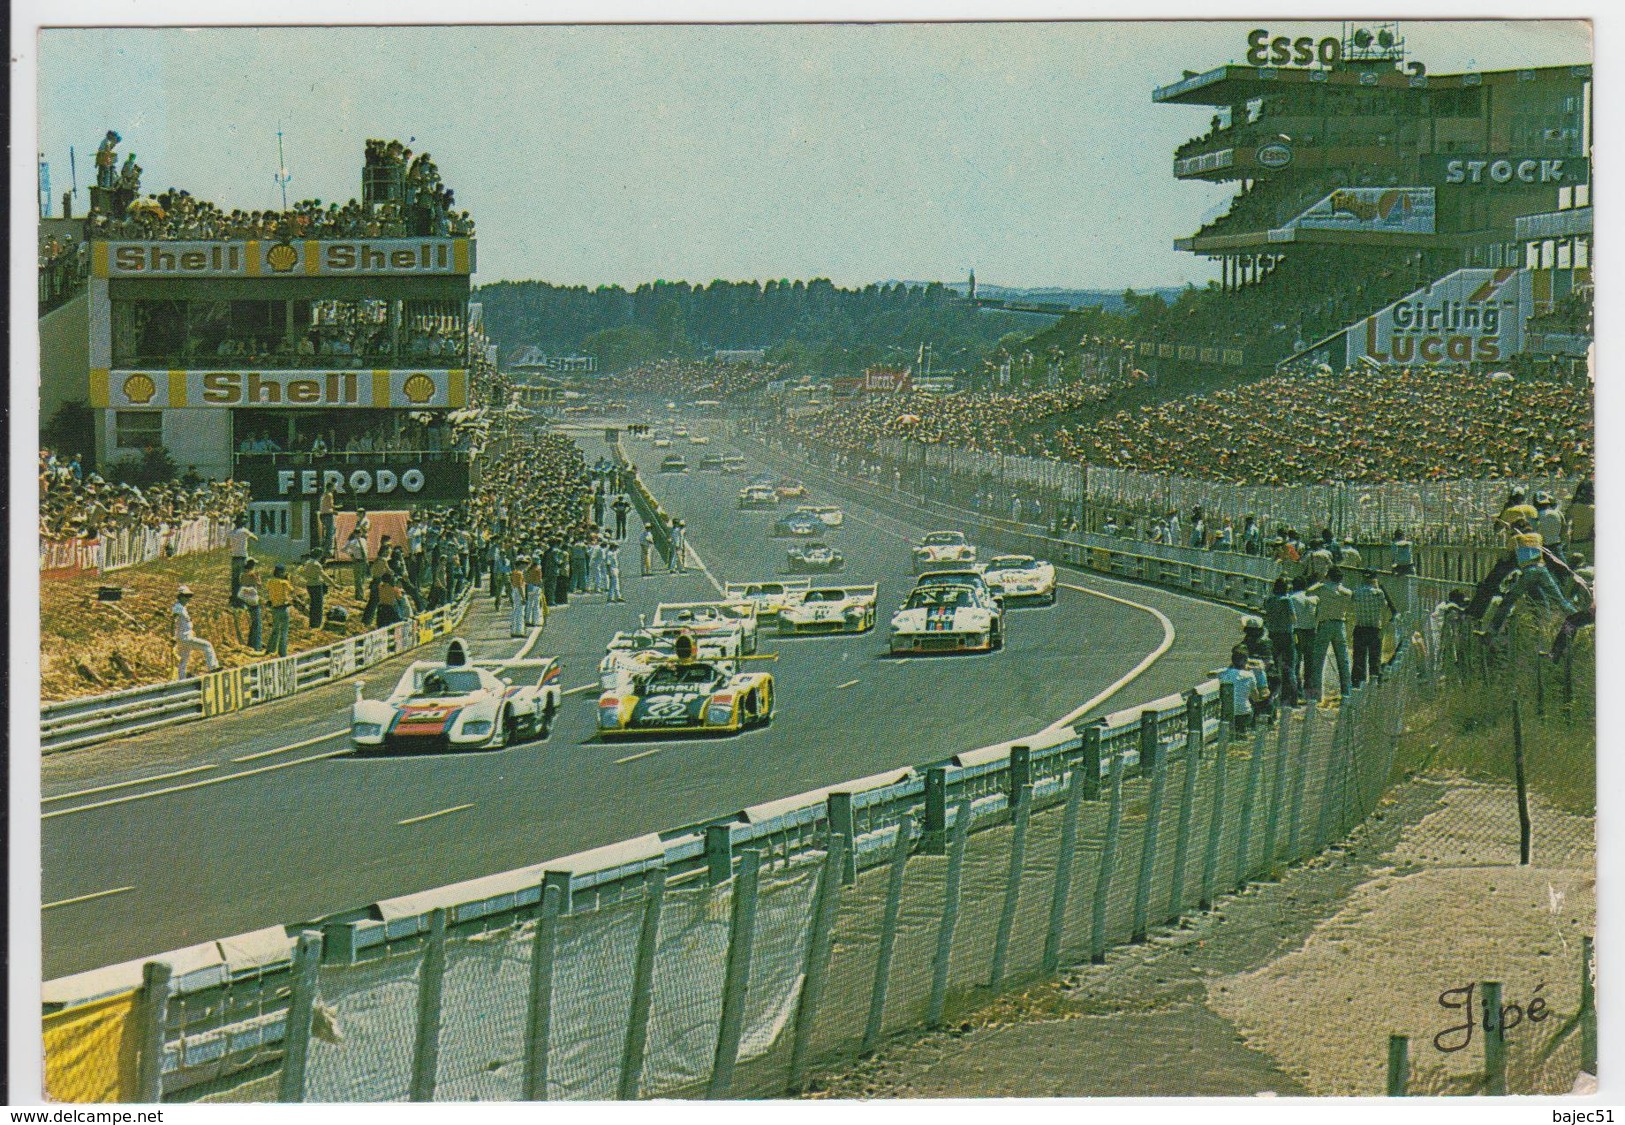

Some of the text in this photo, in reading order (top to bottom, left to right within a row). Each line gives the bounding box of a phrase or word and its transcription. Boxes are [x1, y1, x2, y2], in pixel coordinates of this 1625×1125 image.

[1446, 159, 1565, 185] STOCK
[115, 244, 448, 272] Shell Shell
[1393, 300, 1499, 335] Girling
[1366, 316, 1500, 363] Lucas
[202, 372, 358, 404] Shell
[277, 469, 425, 495] FERODO
[202, 667, 251, 717] CIBIE
